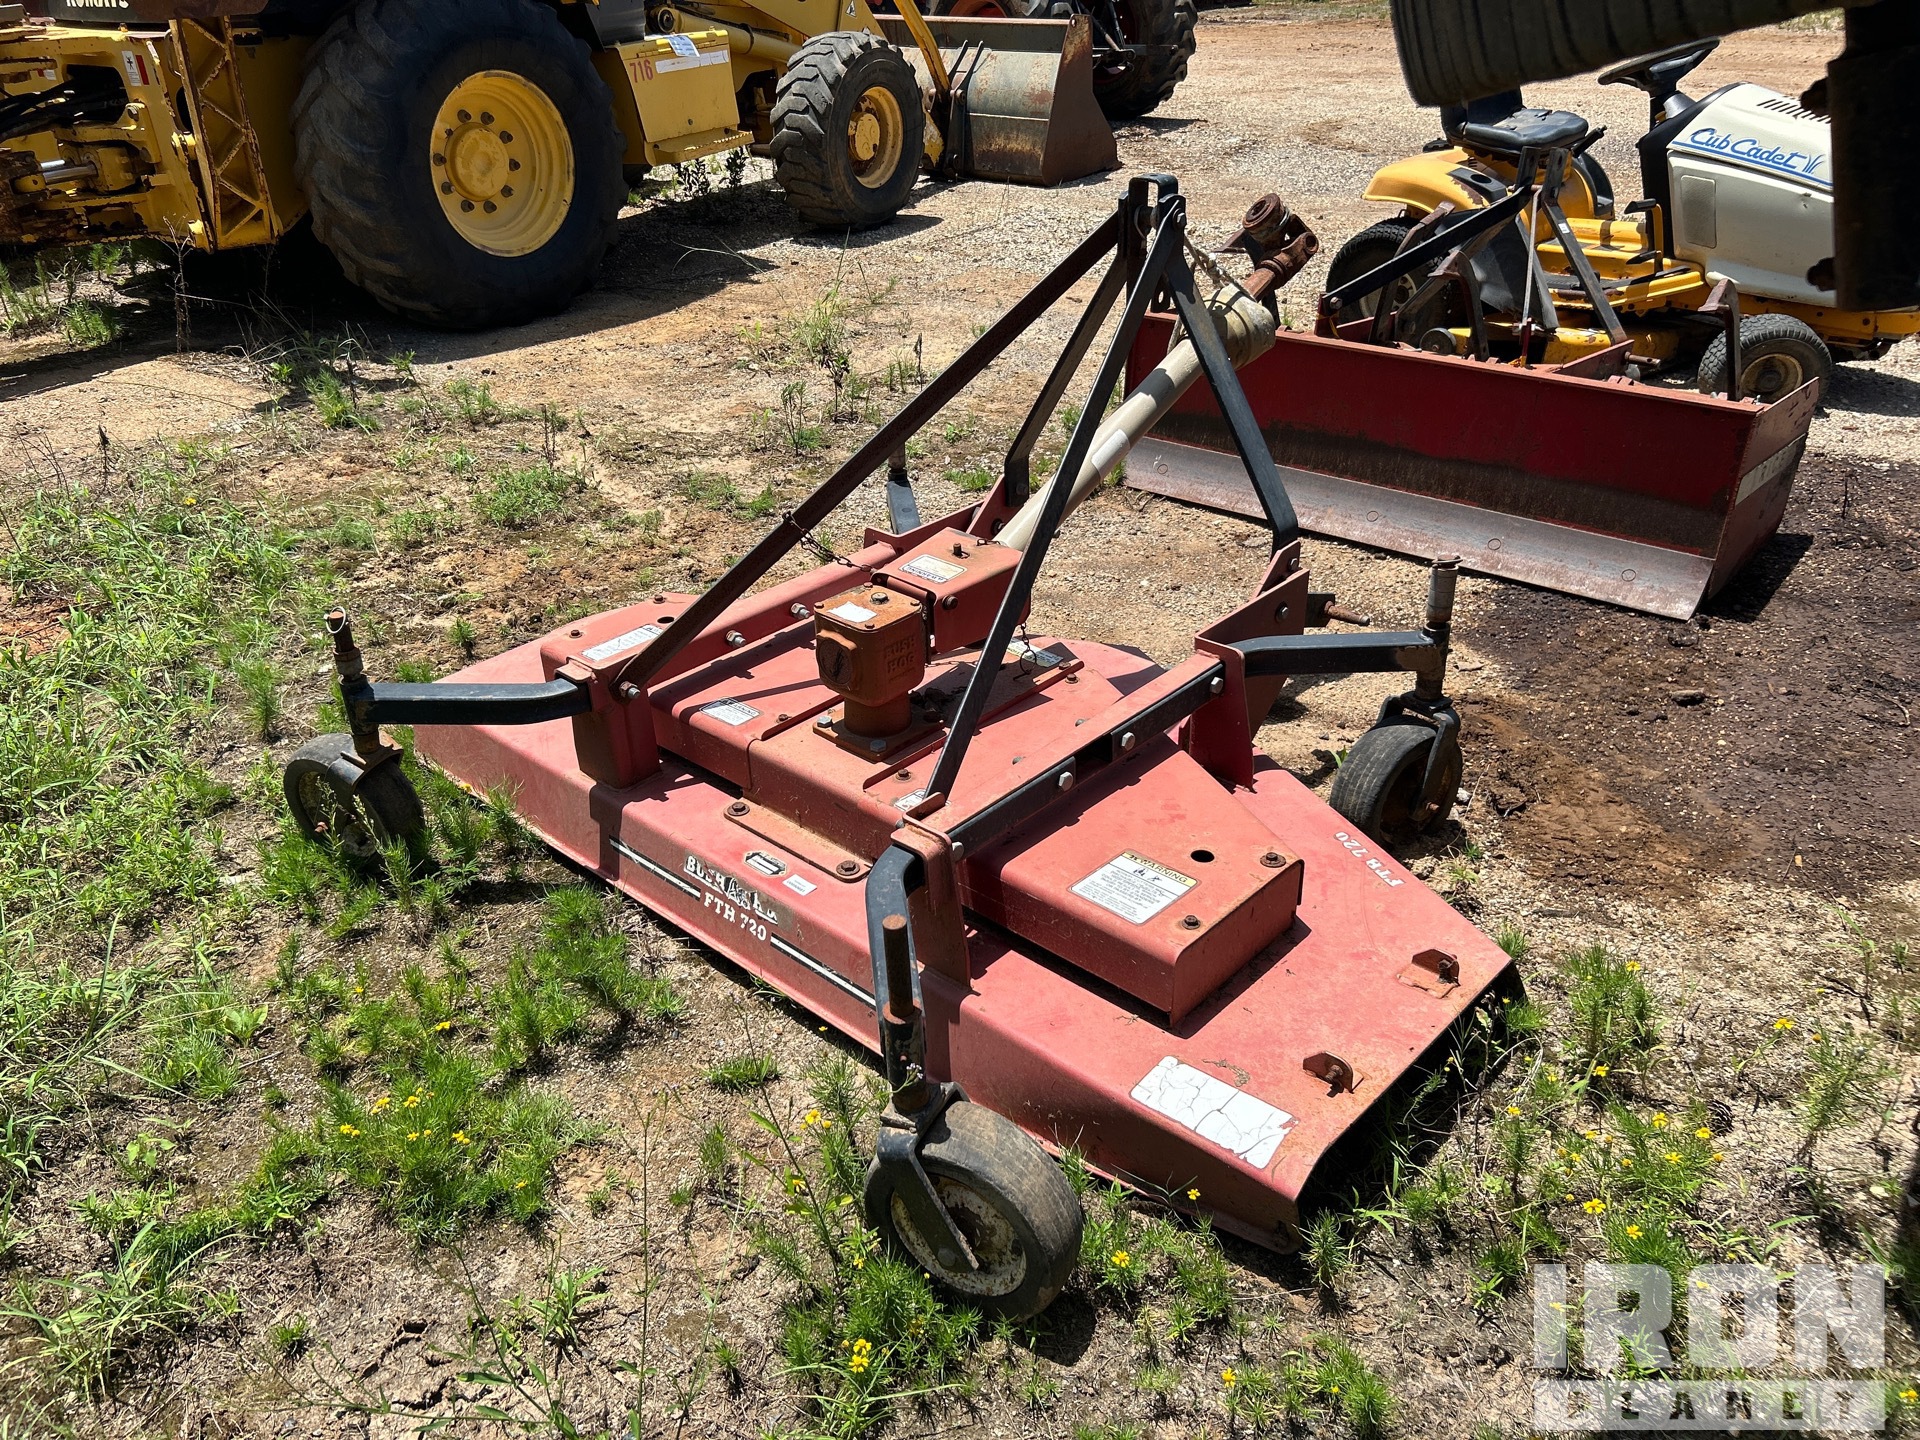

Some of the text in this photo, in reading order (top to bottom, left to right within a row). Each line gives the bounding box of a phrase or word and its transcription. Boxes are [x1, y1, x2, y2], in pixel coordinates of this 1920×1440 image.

[629, 59, 654, 83] 716
[1690, 127, 1807, 170] Cub Cadet
[1140, 859, 1188, 884] WARNING
[1335, 831, 1405, 887] FTH 720
[703, 892, 736, 924] FTH
[739, 912, 768, 941] 720
